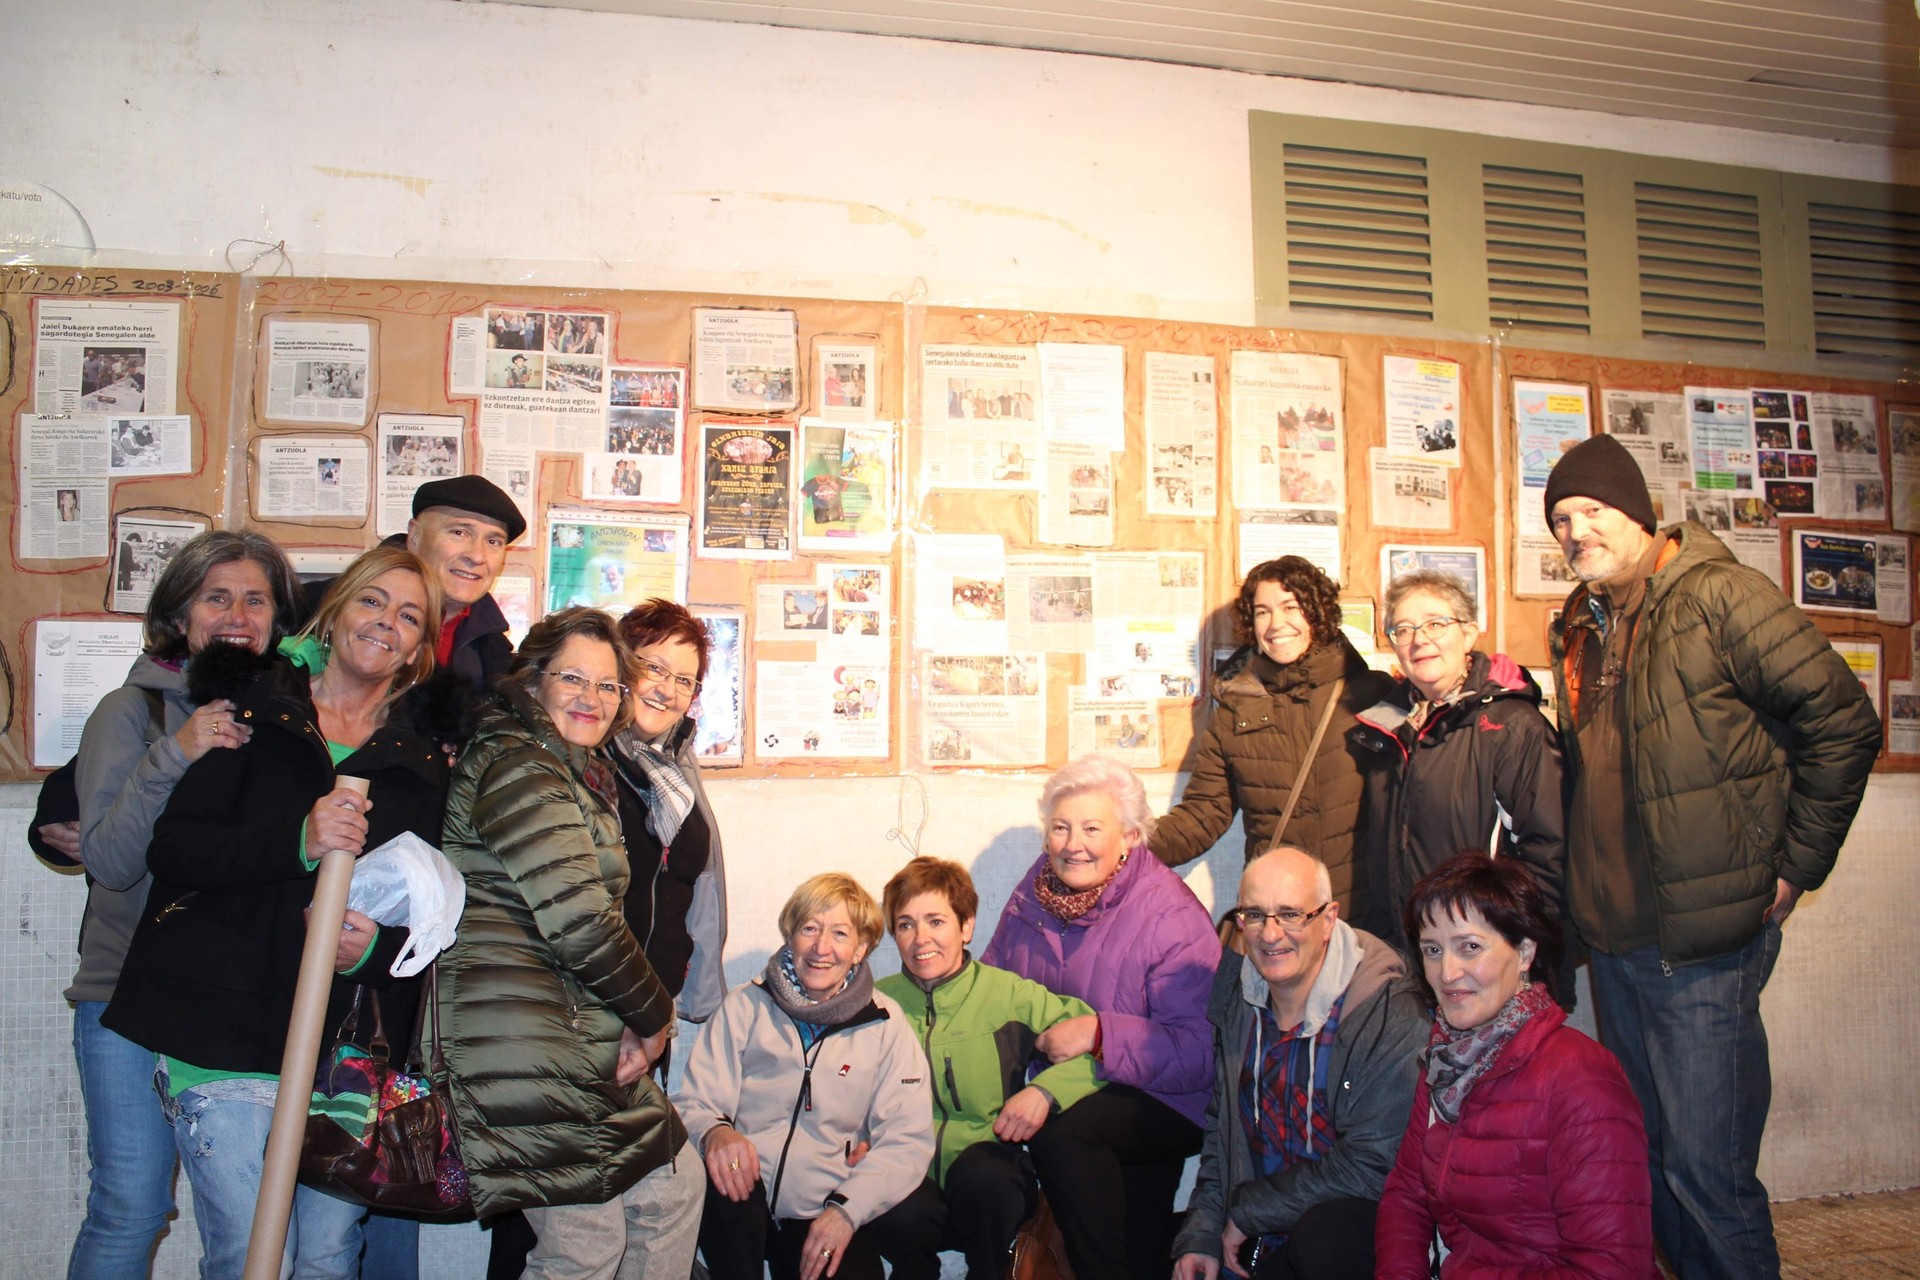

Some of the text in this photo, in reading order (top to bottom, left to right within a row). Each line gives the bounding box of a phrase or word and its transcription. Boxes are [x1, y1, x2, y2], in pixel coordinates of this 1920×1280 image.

[0, 190, 42, 202] katu/vota
[40, 330, 93, 338] sagardotegia
[924, 349, 959, 358] Senegalera
[545, 396, 570, 405] dantza
[572, 398, 596, 406] egiten
[494, 402, 527, 411] dutenak,
[528, 405, 567, 413] guatekean
[568, 406, 601, 414] dantzari
